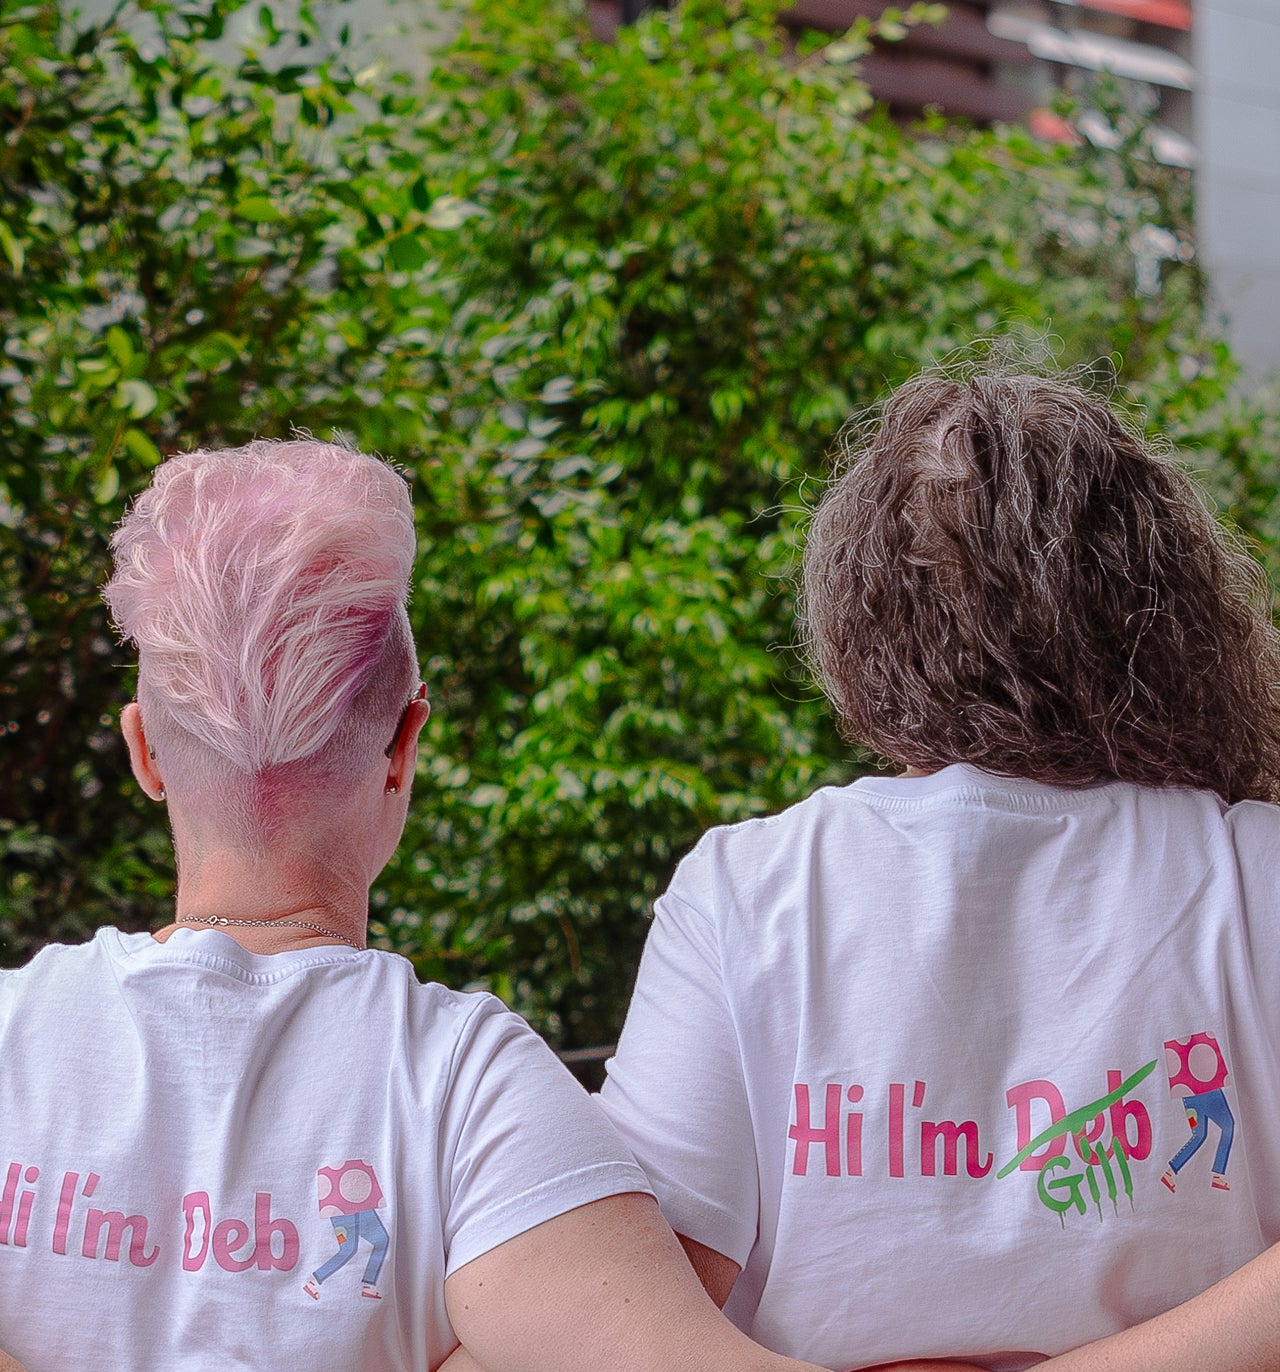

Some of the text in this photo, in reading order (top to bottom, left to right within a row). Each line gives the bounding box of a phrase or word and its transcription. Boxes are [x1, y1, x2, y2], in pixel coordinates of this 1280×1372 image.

[788, 1069, 1152, 1179] Hi I'm Deb
[52, 1170, 161, 1268] I'm
[181, 1190, 300, 1273] Deb
[1037, 1136, 1136, 1226] Gill
